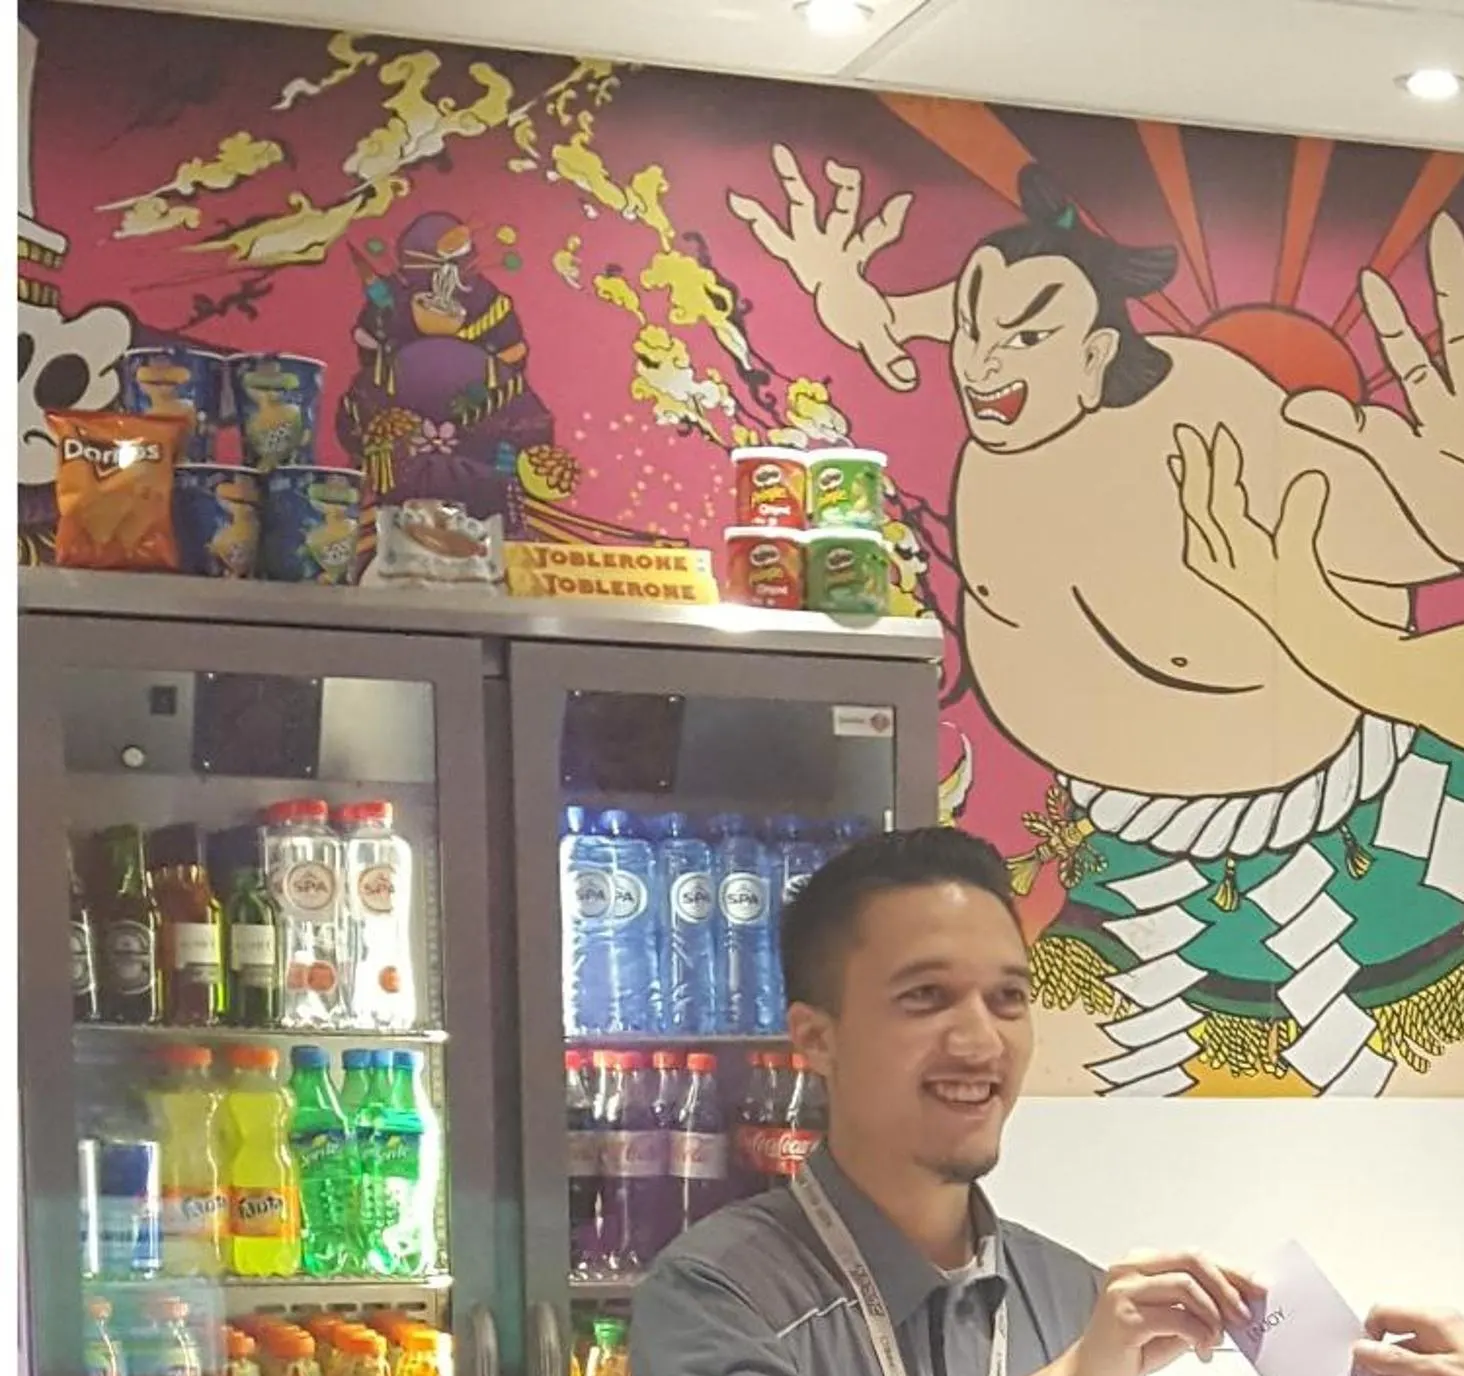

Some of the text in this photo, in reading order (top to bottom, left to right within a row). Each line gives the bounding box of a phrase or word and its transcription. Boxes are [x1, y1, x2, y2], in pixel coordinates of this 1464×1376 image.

[64, 438, 160, 464] Dorios
[532, 547, 688, 571] TOBLERONE
[543, 573, 696, 600] TOBLERONE
